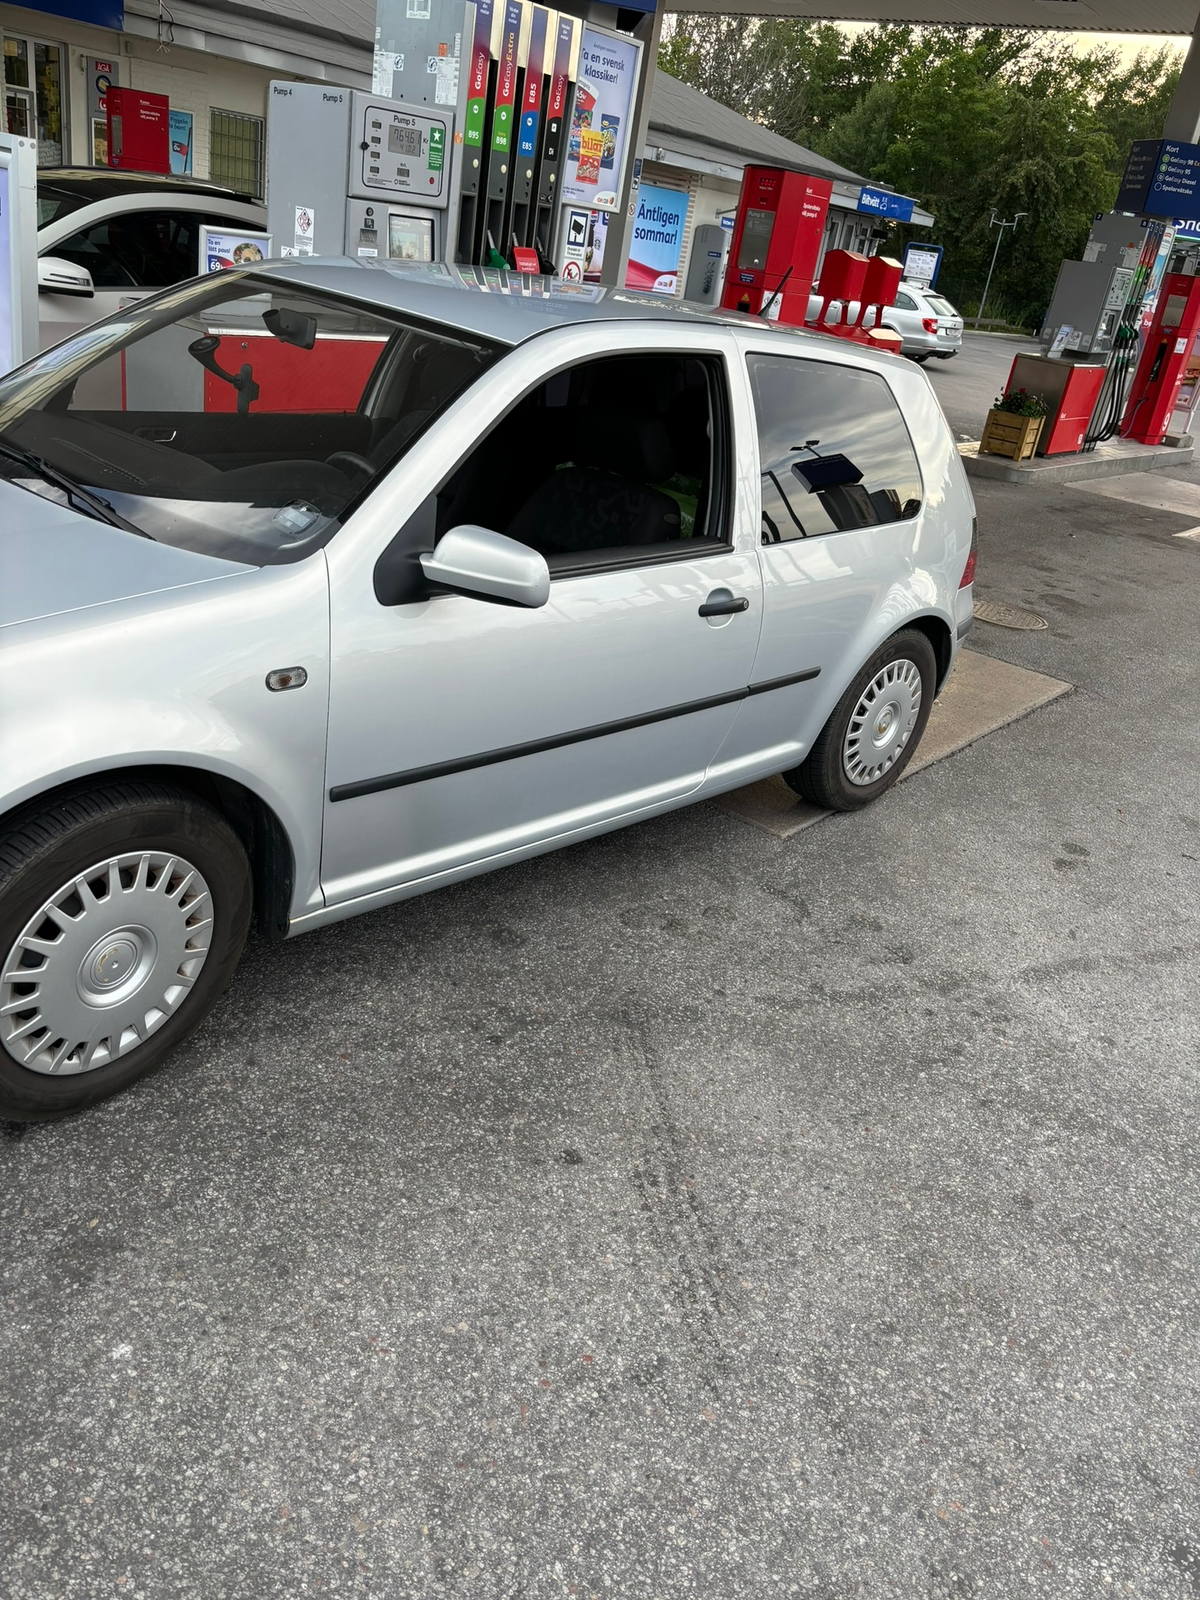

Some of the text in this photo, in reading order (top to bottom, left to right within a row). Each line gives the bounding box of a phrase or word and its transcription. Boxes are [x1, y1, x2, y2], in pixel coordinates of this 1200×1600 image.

[97, 62, 110, 73] AGA
[590, 54, 600, 64] en
[602, 57, 625, 71] svensk
[474, 52, 486, 90] GoEasy
[584, 64, 619, 84] klassiker!
[273, 86, 293, 96] Pump 4
[528, 83, 537, 104] E85
[554, 74, 565, 110] GoEasy
[322, 93, 343, 103] Pump 5
[393, 114, 411, 126] Pump
[468, 130, 479, 139] B95
[495, 136, 507, 146] B98
[522, 141, 532, 151] E85
[581, 136, 603, 153] bilar
[1165, 145, 1180, 153] Kort
[1181, 178, 1197, 186] Diesel
[636, 199, 680, 228] Äntligen
[748, 210, 760, 218] Pump
[634, 226, 679, 245] sommar!
